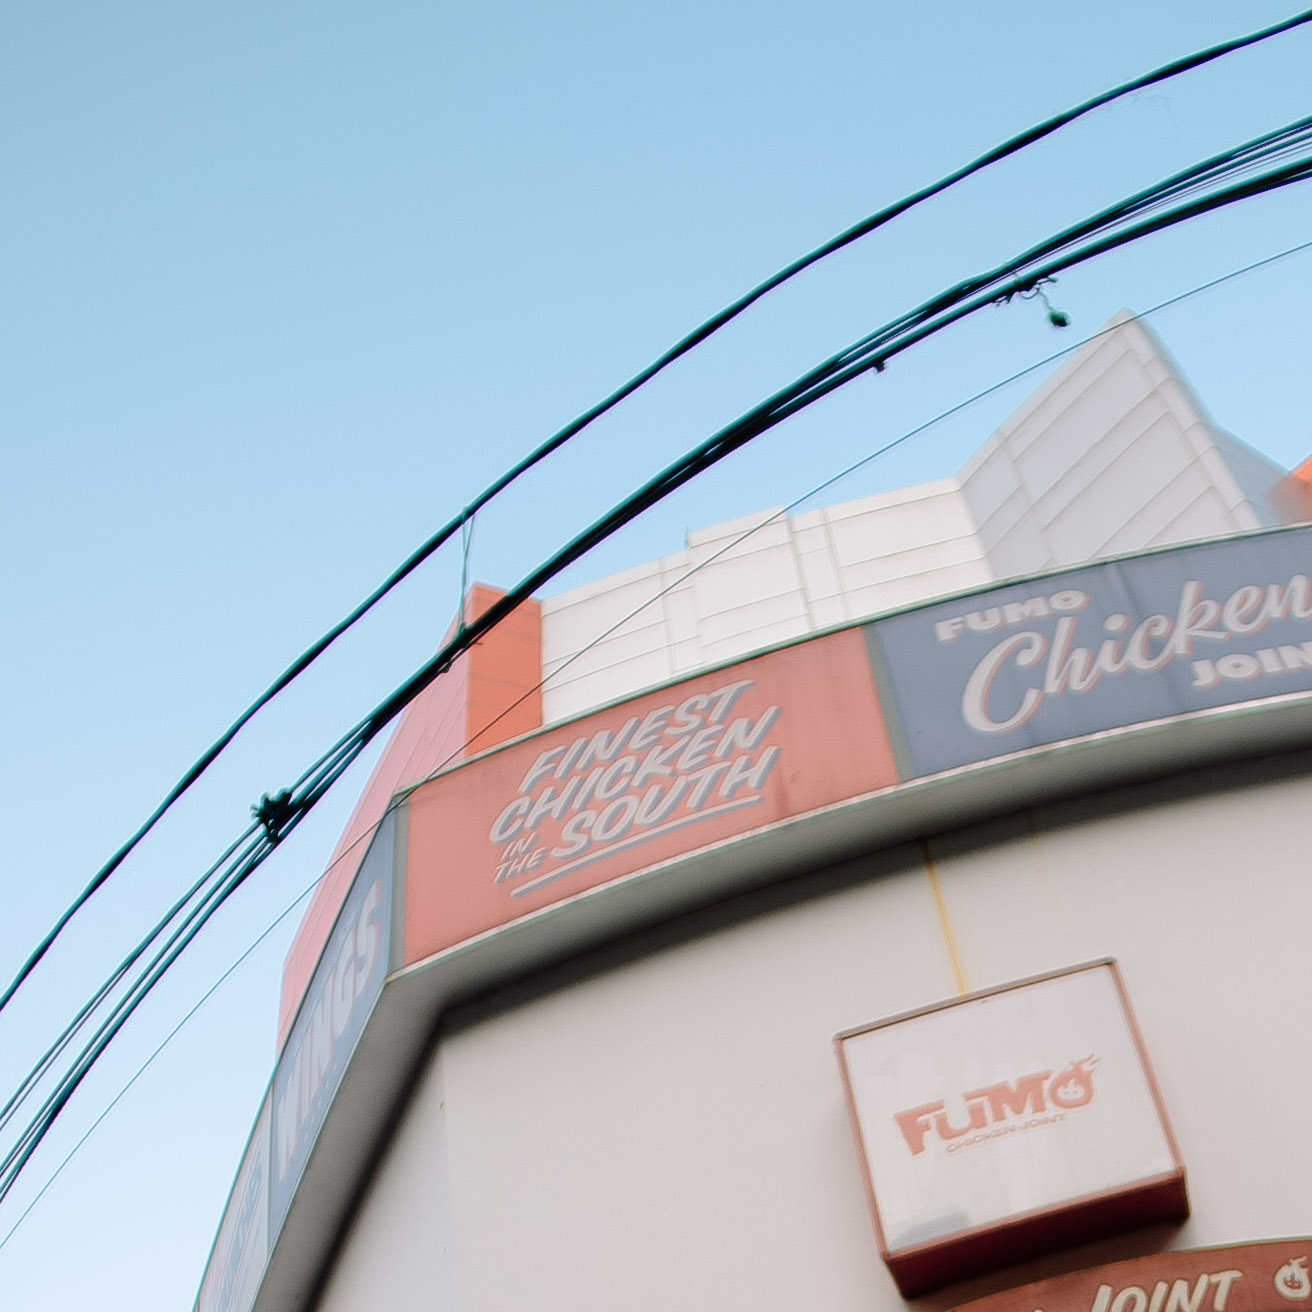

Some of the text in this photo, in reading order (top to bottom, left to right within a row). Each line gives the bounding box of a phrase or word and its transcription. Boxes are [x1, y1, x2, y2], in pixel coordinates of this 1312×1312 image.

[934, 589, 1092, 642] FUMO
[490, 706, 781, 843] CHICKEN
[519, 679, 755, 794] FINEST
[502, 832, 537, 860] IN
[551, 746, 781, 857] SOUTH
[494, 847, 546, 883] THE
[894, 1053, 1101, 1156] FUMO
